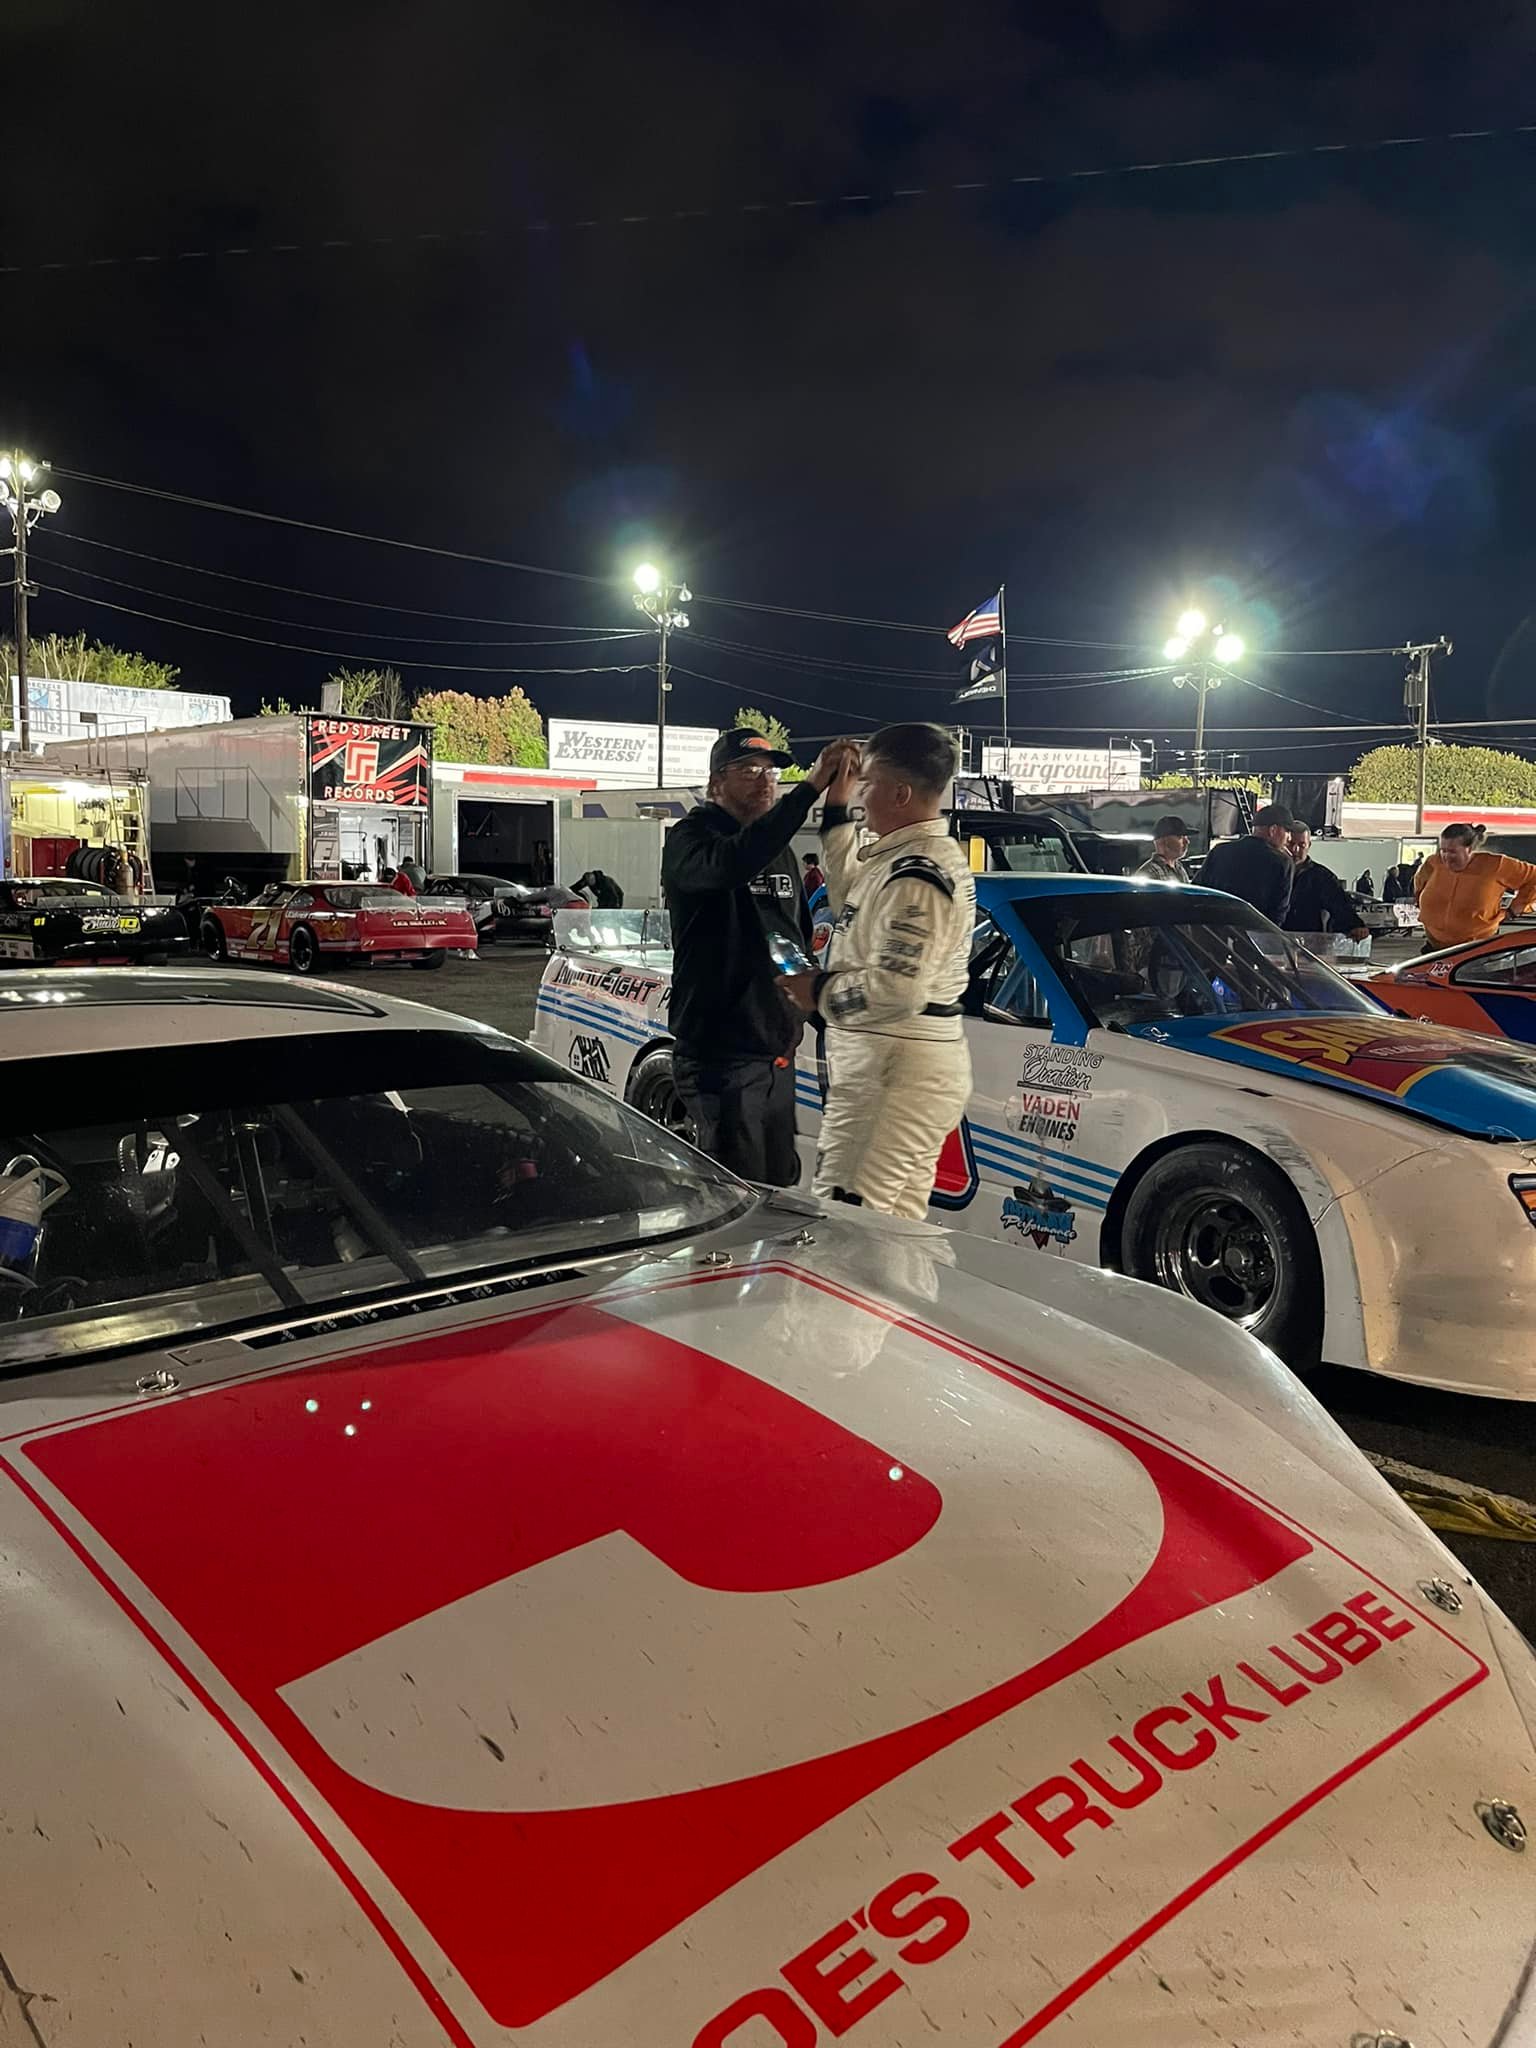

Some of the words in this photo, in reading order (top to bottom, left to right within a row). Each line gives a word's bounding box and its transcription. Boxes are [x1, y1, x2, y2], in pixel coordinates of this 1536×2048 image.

[555, 742, 642, 762] EXPRESS!
[563, 731, 647, 750] WESTERN
[324, 786, 395, 801] RECORDS
[246, 911, 283, 950] 71
[1023, 1043, 1104, 1069] STANDING
[1023, 1056, 1092, 1091] Ovation
[1023, 1093, 1080, 1121] VADEN
[1018, 1114, 1077, 1141] ENGINES
[946, 1674, 1271, 1889] TRUCK
[1236, 1590, 1416, 1706] LUBE
